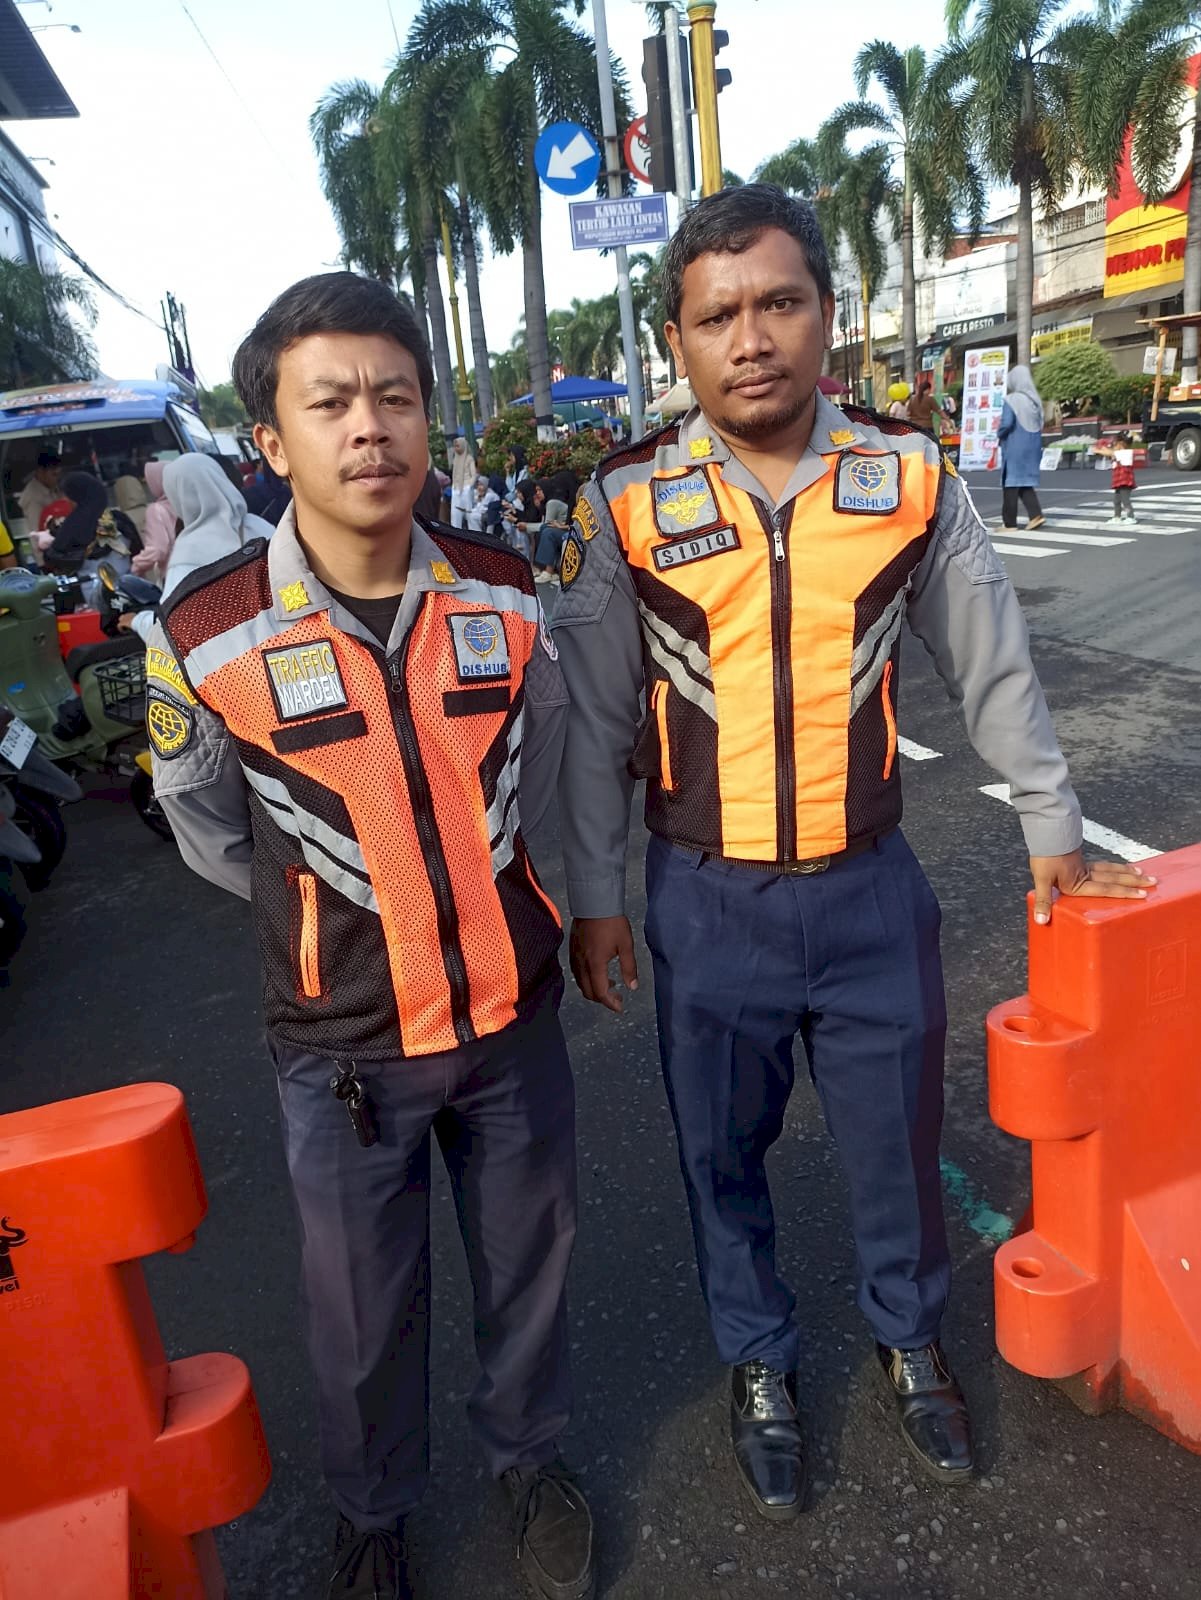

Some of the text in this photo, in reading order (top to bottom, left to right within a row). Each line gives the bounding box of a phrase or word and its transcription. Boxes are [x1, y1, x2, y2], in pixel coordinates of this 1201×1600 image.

[595, 202, 642, 218] KAWASAN
[634, 212, 663, 226] LINTAS
[943, 318, 995, 337] CAFE & RESTO
[658, 481, 704, 501] DISHUB
[843, 495, 894, 509] DISHUB
[661, 532, 728, 564] SIDIQ
[267, 645, 337, 686] TRAFFIC
[462, 663, 508, 676] DISHUB
[275, 674, 347, 713] WARDEN
